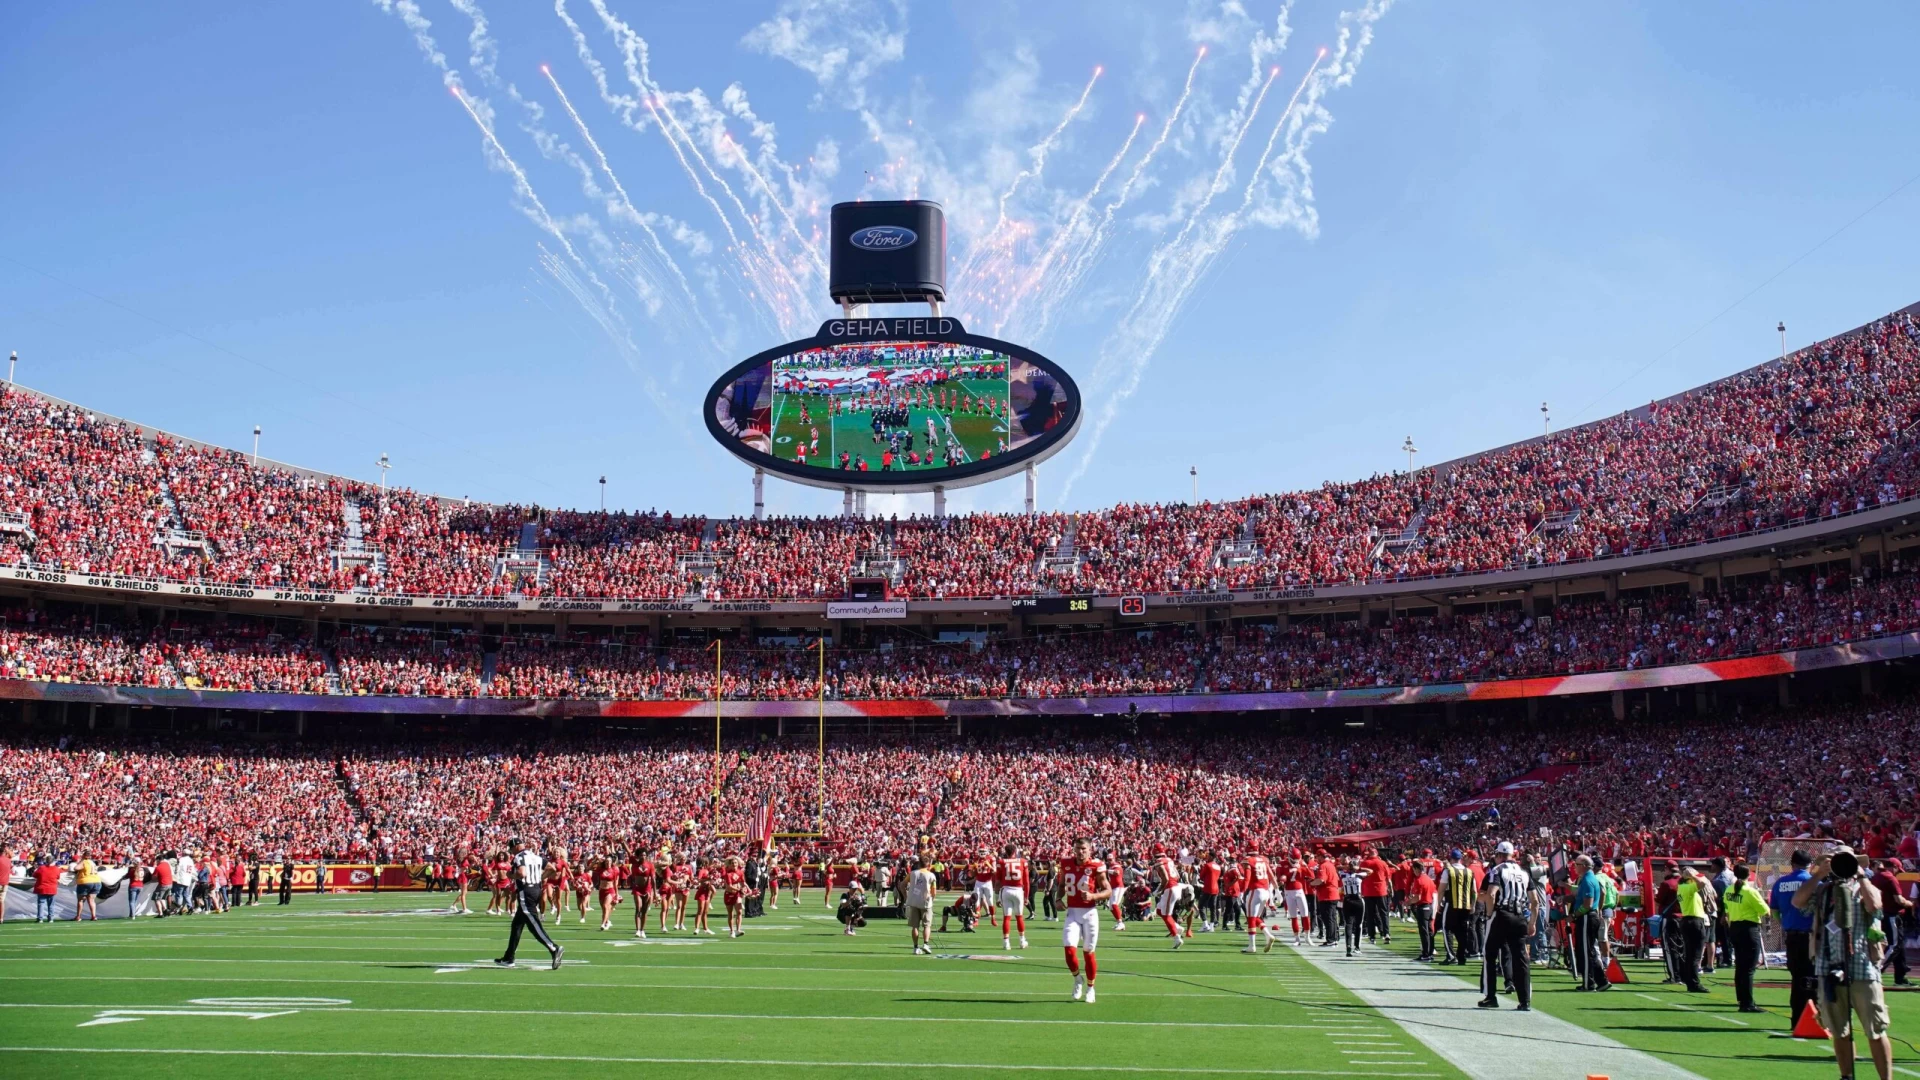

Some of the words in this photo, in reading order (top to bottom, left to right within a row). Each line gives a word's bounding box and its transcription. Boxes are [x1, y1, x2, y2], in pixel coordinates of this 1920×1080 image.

[863, 229, 903, 246] Ford
[829, 320, 888, 336] GEHA
[895, 319, 953, 335] FIELD
[1026, 369, 1050, 377] DEM
[26, 571, 36, 580] K.
[38, 572, 67, 583] ROSS
[101, 579, 113, 588] W.
[115, 580, 159, 592] SHIELDS
[192, 587, 203, 595] G.
[205, 587, 254, 598] BARBARO
[295, 593, 336, 603] HOLMES
[1265, 592, 1275, 600] K.
[1276, 590, 1315, 599] ANDERS
[367, 597, 378, 605] G.
[380, 597, 414, 606] GREEN
[445, 600, 454, 608] T.
[456, 600, 519, 609] RICHARDSON
[1176, 596, 1184, 604] T.
[1185, 594, 1235, 604] GRUNHARD
[552, 602, 562, 610] C.
[563, 602, 603, 610] CARSON
[642, 603, 694, 611] GONZALEZ
[1070, 600, 1088, 611] 3:45
[1124, 599, 1142, 613] 25
[1004, 863, 1022, 881] 15
[1064, 873, 1090, 897] 84
